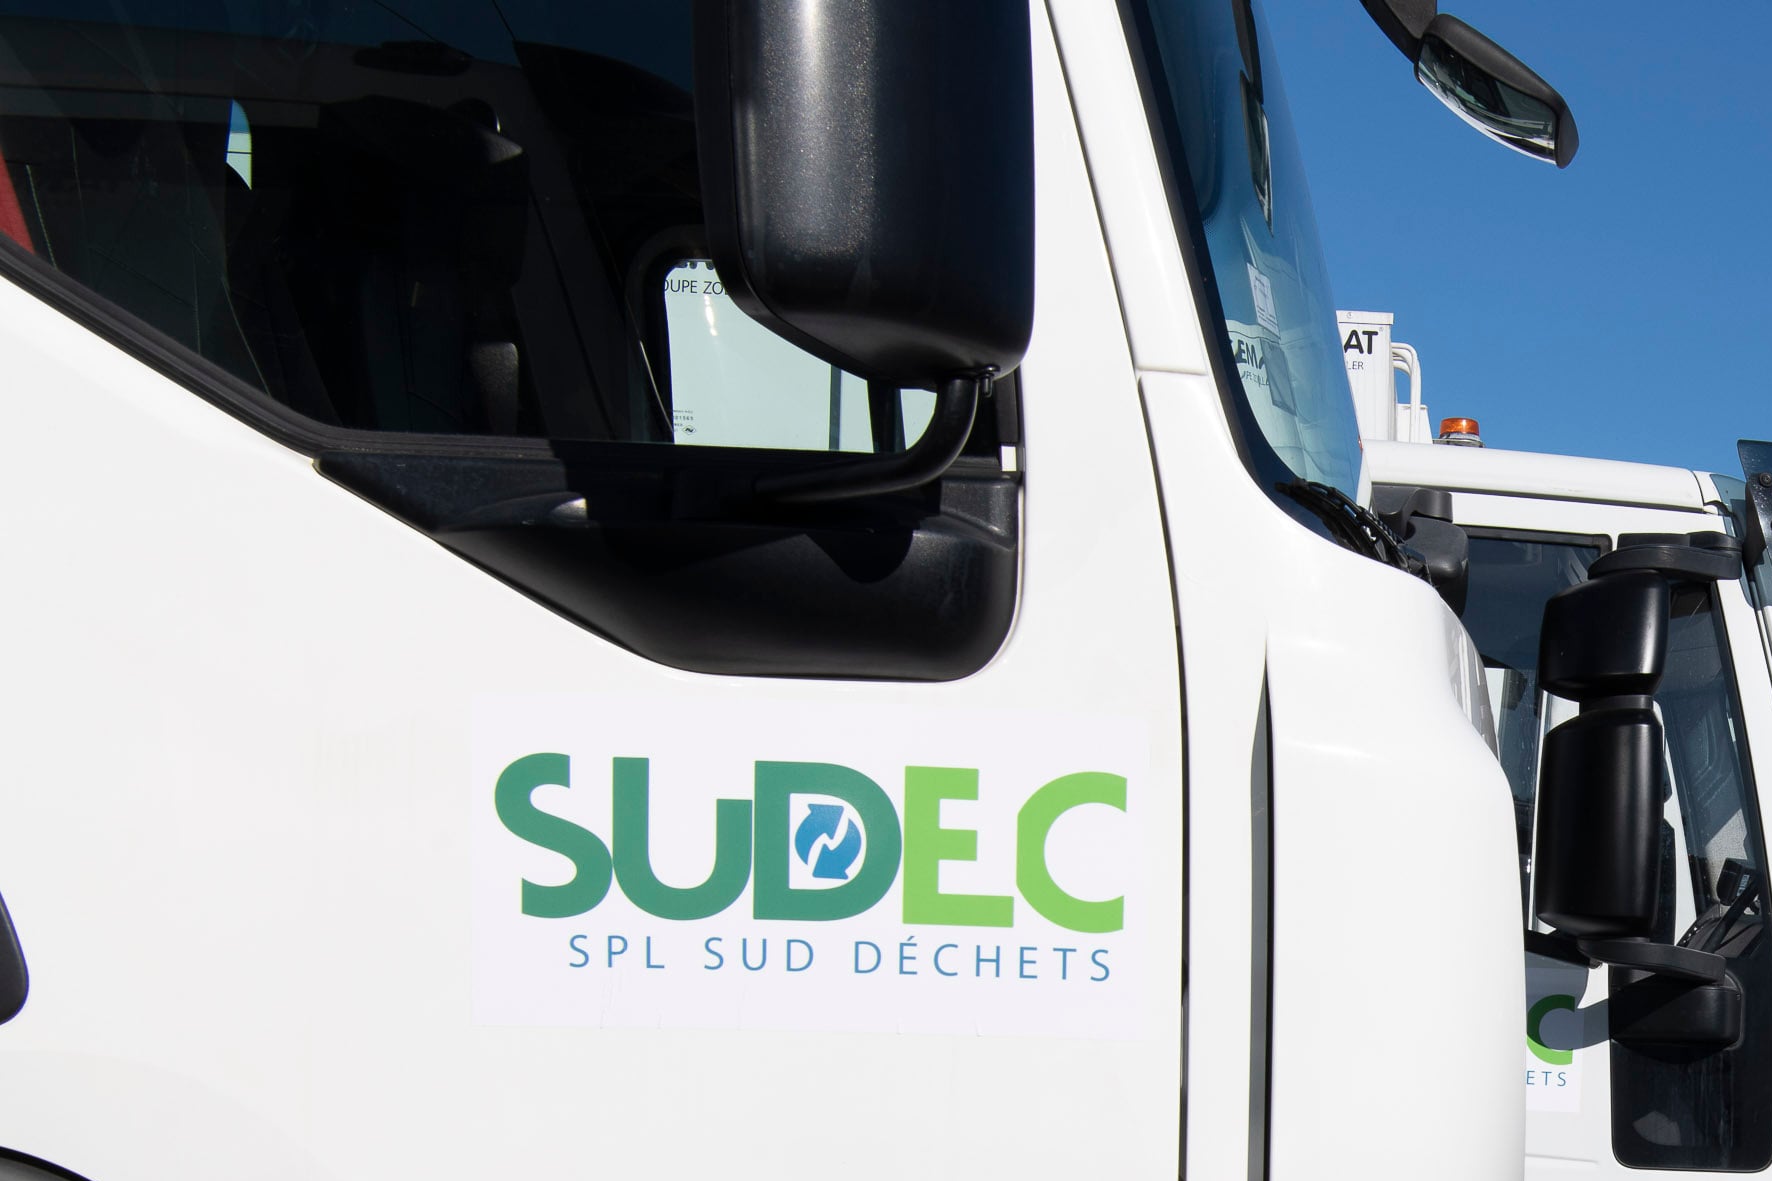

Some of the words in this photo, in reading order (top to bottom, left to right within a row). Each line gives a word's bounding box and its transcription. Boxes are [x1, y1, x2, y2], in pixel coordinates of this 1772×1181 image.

[703, 281, 728, 295] ZO
[494, 752, 1127, 934] SUDEC
[569, 934, 665, 970] SPL
[704, 937, 814, 972] SUD
[853, 936, 1111, 982] DÉCHETS
